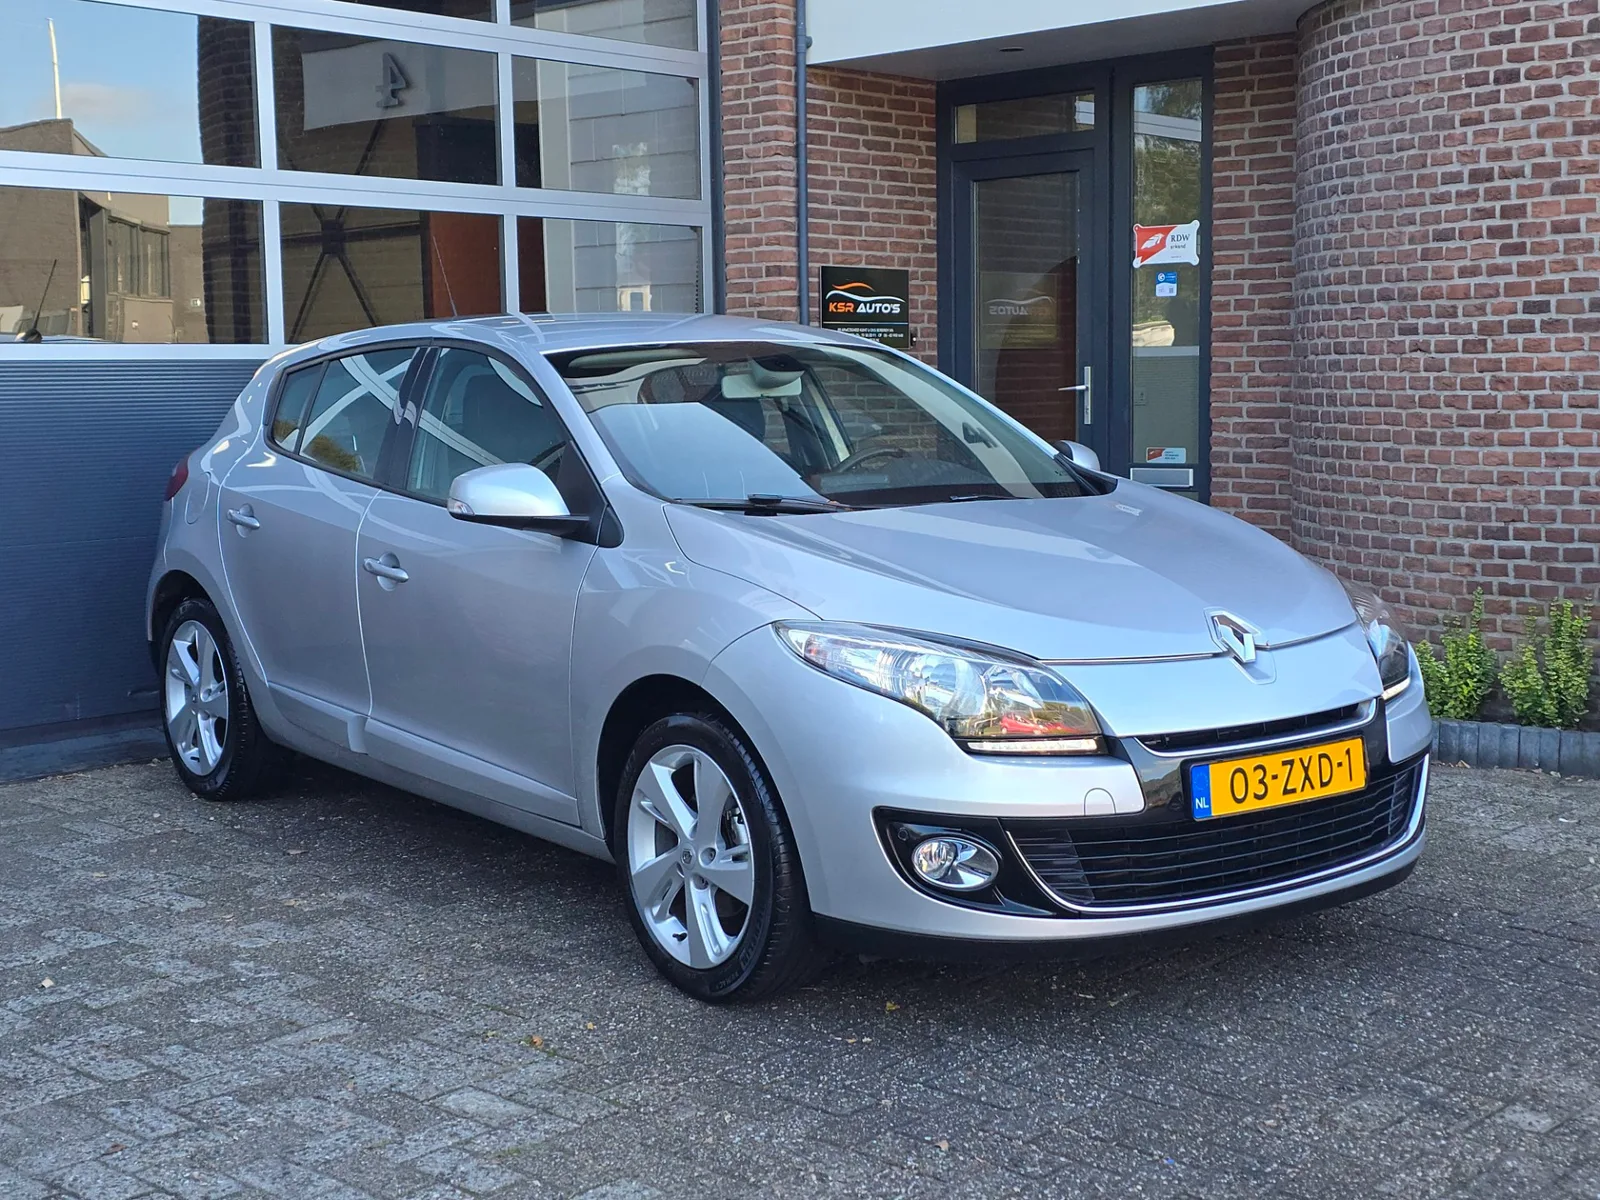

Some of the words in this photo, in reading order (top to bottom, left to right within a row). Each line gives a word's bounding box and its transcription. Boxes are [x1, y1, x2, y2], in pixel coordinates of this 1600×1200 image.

[1170, 234, 1190, 242] RDW
[829, 302, 854, 312] KSR
[1230, 748, 1353, 804] 03-ZXD-1
[1195, 797, 1209, 809] NL
